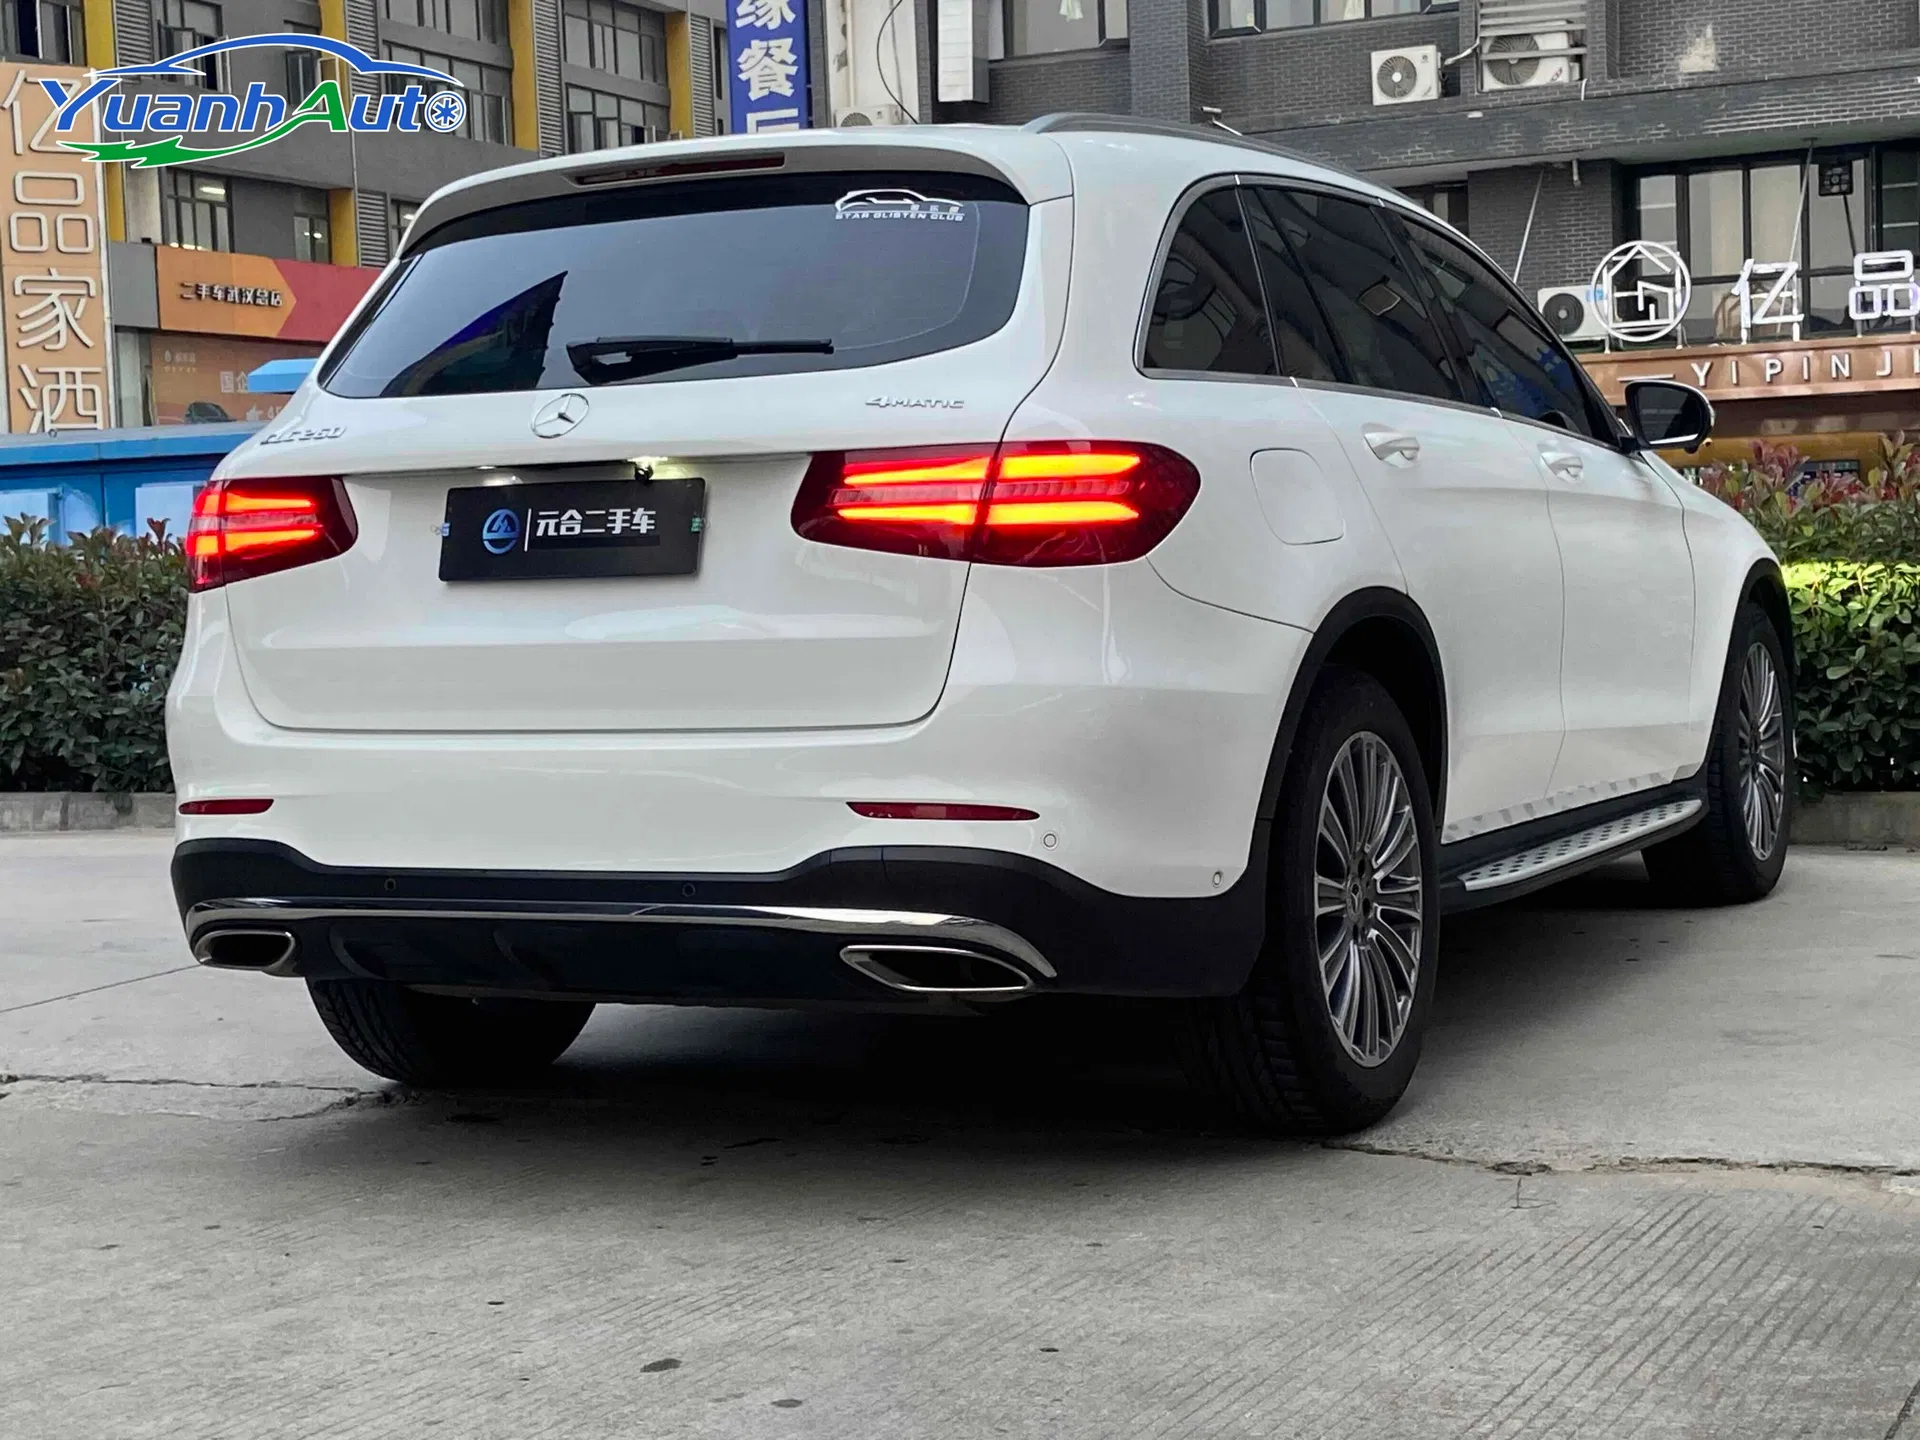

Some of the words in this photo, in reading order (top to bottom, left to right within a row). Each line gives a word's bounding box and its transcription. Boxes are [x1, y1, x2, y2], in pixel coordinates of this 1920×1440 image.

[180, 282, 283, 307] 二手车武汉总店
[1731, 249, 1920, 330] 亿品
[865, 396, 964, 409] 4MATIC
[535, 507, 657, 537] 元合二手车
